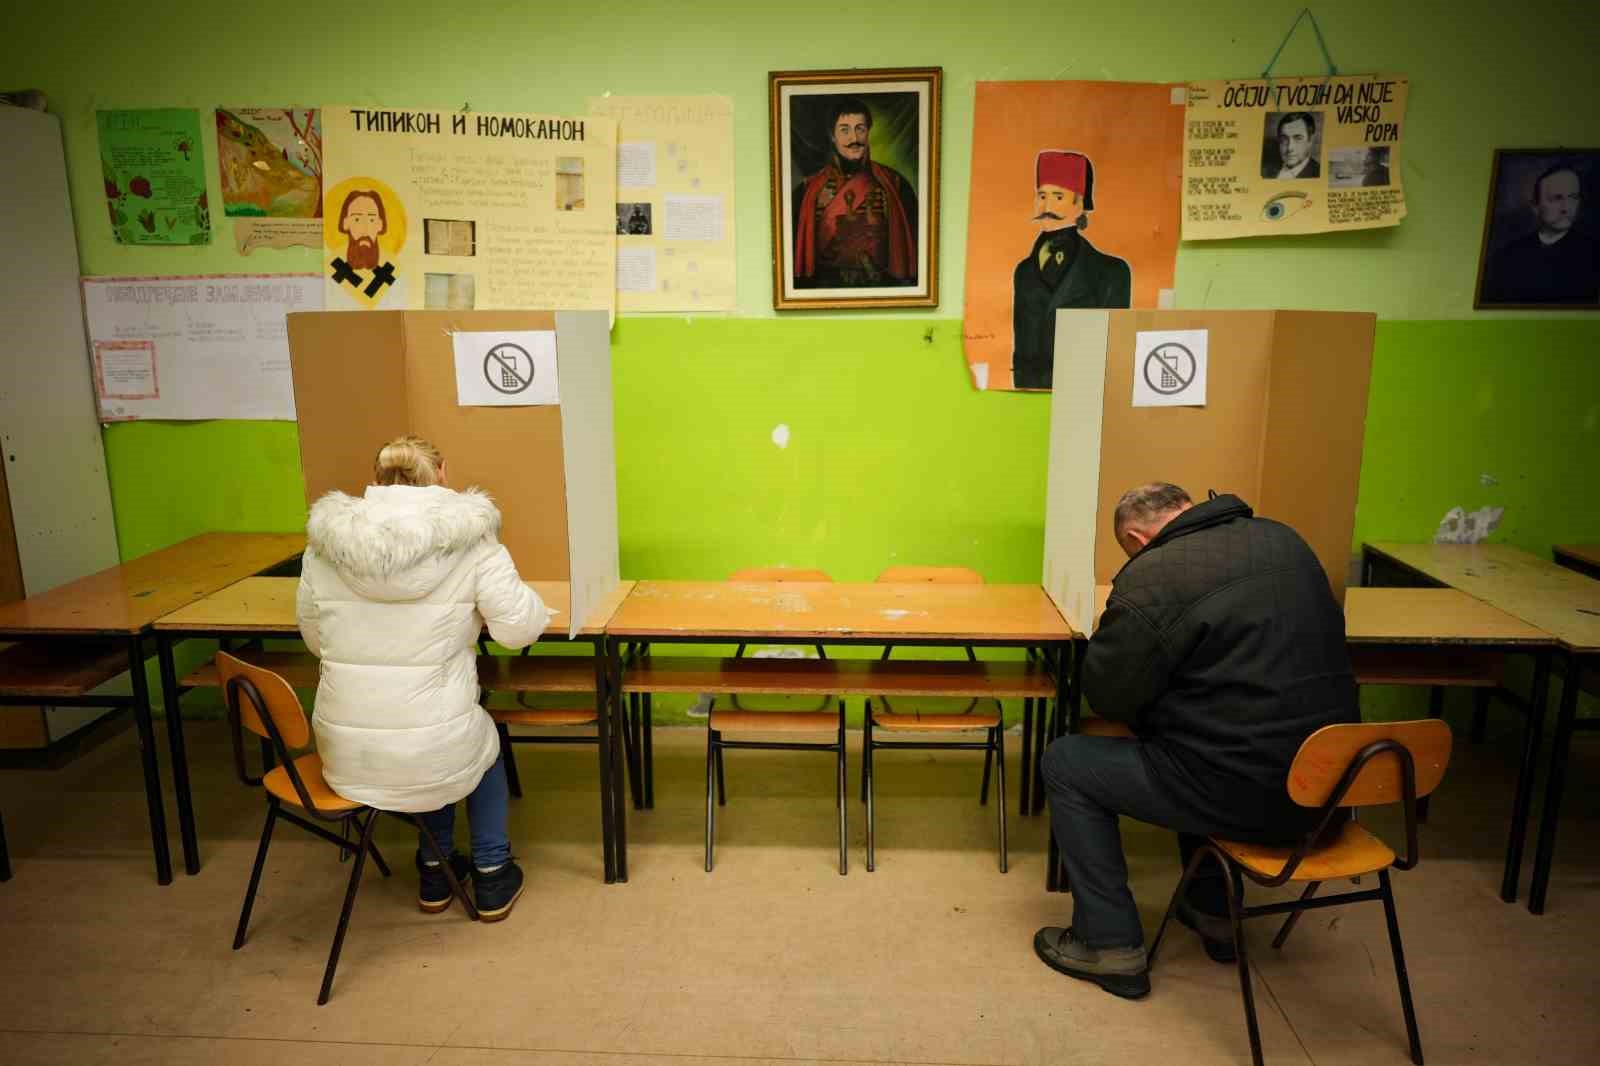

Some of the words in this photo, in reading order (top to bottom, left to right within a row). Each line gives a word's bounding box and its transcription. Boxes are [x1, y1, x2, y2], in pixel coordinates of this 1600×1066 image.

[1276, 84, 1332, 106] TVOJIH
[1333, 83, 1353, 105] DA
[1336, 105, 1381, 124] VASKO
[350, 110, 440, 134] ТИПИКОН
[452, 114, 466, 135] И
[477, 115, 584, 141] НОМОКАНОН
[1364, 123, 1399, 142] POPA
